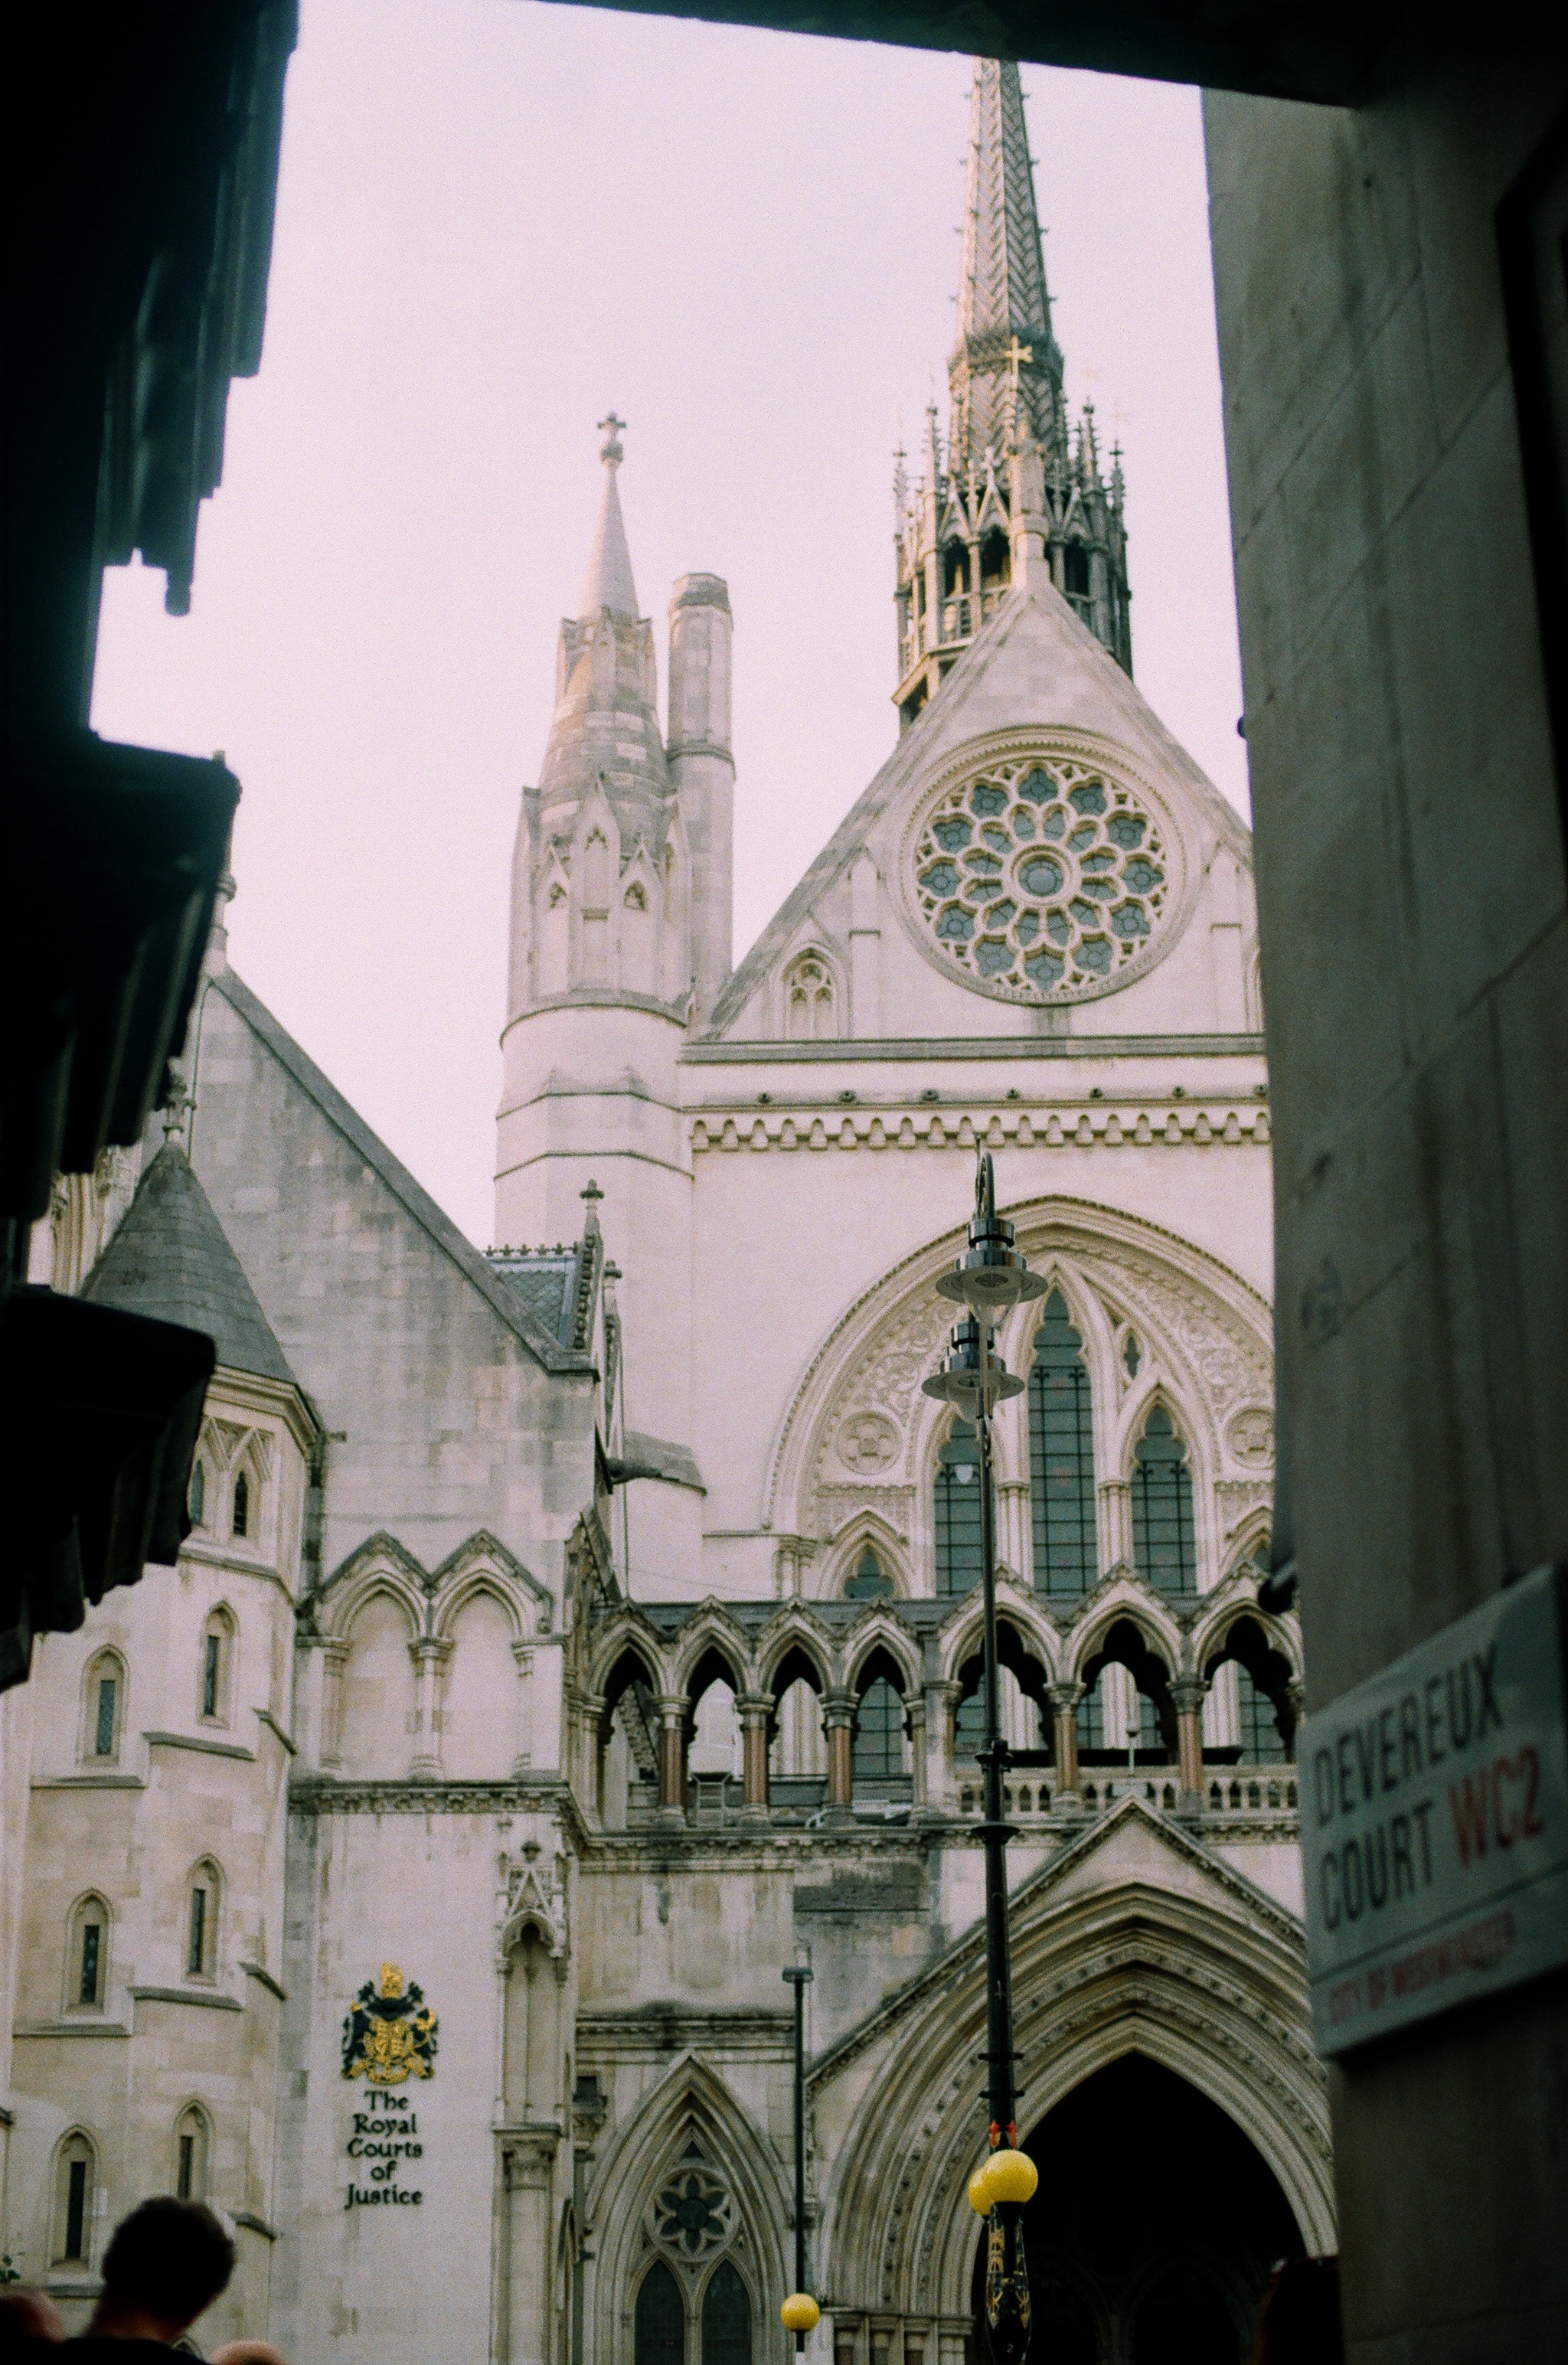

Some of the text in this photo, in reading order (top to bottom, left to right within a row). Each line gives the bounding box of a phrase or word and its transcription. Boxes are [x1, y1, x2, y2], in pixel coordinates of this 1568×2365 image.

[1314, 1642, 1504, 1828] DEVEREUX
[1320, 1743, 1545, 1931] COURT WC2
[364, 2090, 408, 2111] The
[352, 2113, 417, 2138] Royal
[347, 2138, 422, 2159] Courts
[371, 2160, 397, 2181] of
[345, 2184, 422, 2210] Justice
[1007, 2344, 1014, 2353] 2
